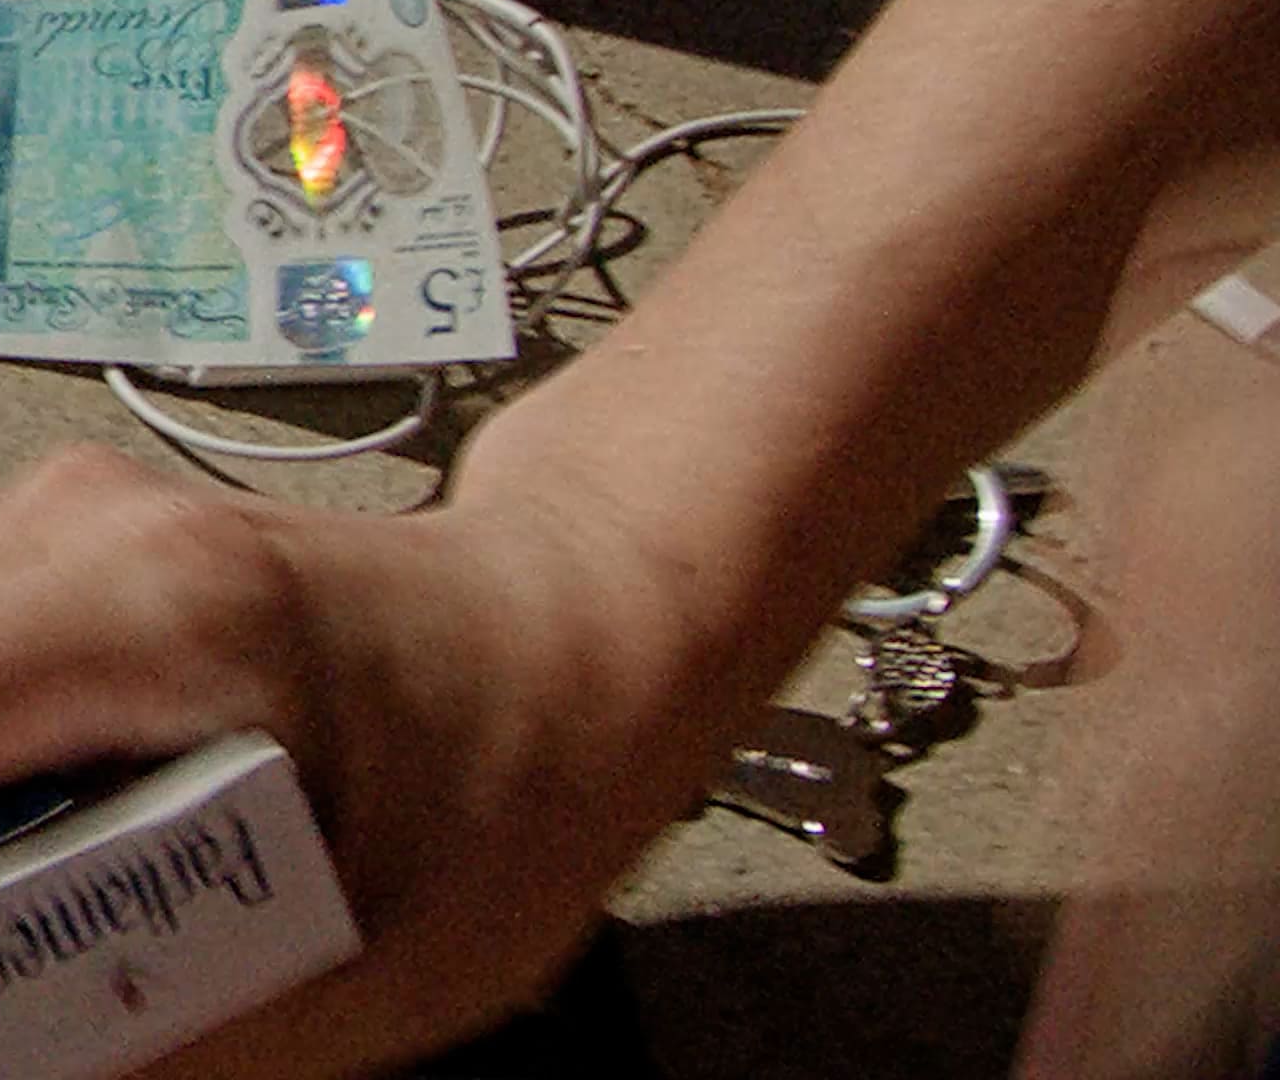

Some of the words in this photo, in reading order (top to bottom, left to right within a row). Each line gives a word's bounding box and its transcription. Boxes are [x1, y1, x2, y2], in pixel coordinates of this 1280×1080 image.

[34, 0, 232, 67] Pounds
[131, 68, 220, 105] Five
[422, 268, 486, 338] £5
